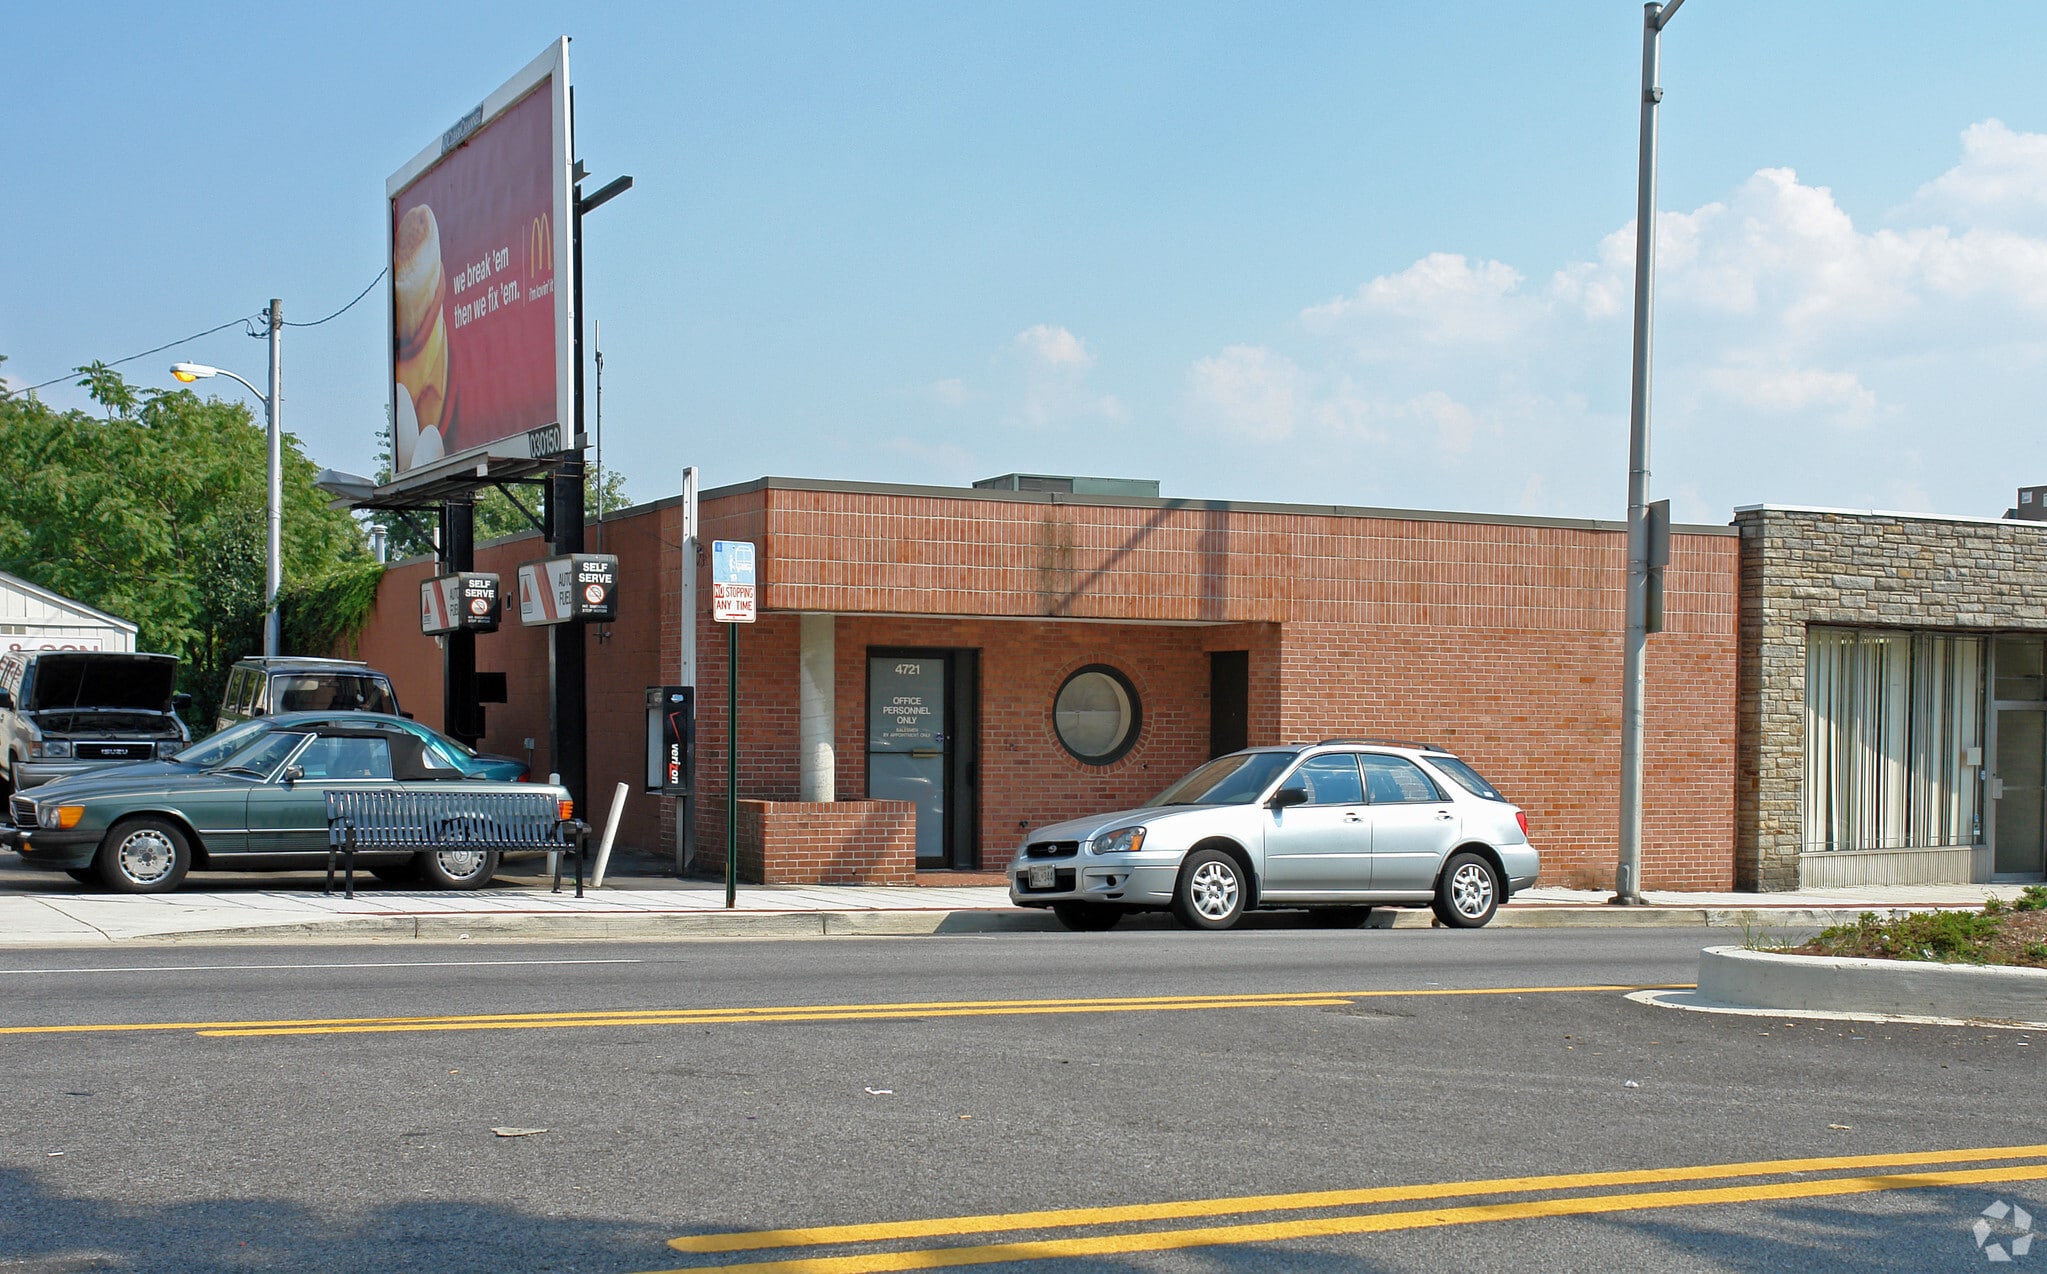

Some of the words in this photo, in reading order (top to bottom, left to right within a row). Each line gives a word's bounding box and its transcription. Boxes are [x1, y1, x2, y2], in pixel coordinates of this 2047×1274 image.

[453, 271, 466, 295] we
[467, 252, 491, 288] break
[454, 303, 473, 329] then
[473, 295, 487, 320] we
[487, 285, 499, 313] fix
[529, 427, 560, 458] 030150
[583, 562, 608, 572] SELF
[578, 573, 612, 583] SERVE
[468, 579, 491, 588] SELF
[465, 589, 495, 598] SERVE
[714, 585, 724, 597] NO
[726, 586, 753, 598] STOPPING
[716, 600, 732, 610] ANY
[736, 600, 753, 611] TIME
[895, 663, 920, 675] 4721
[893, 697, 922, 705] OFFICE
[883, 707, 931, 715] PERSONNEL
[896, 716, 917, 724] ONLY
[668, 743, 681, 785] verizon
